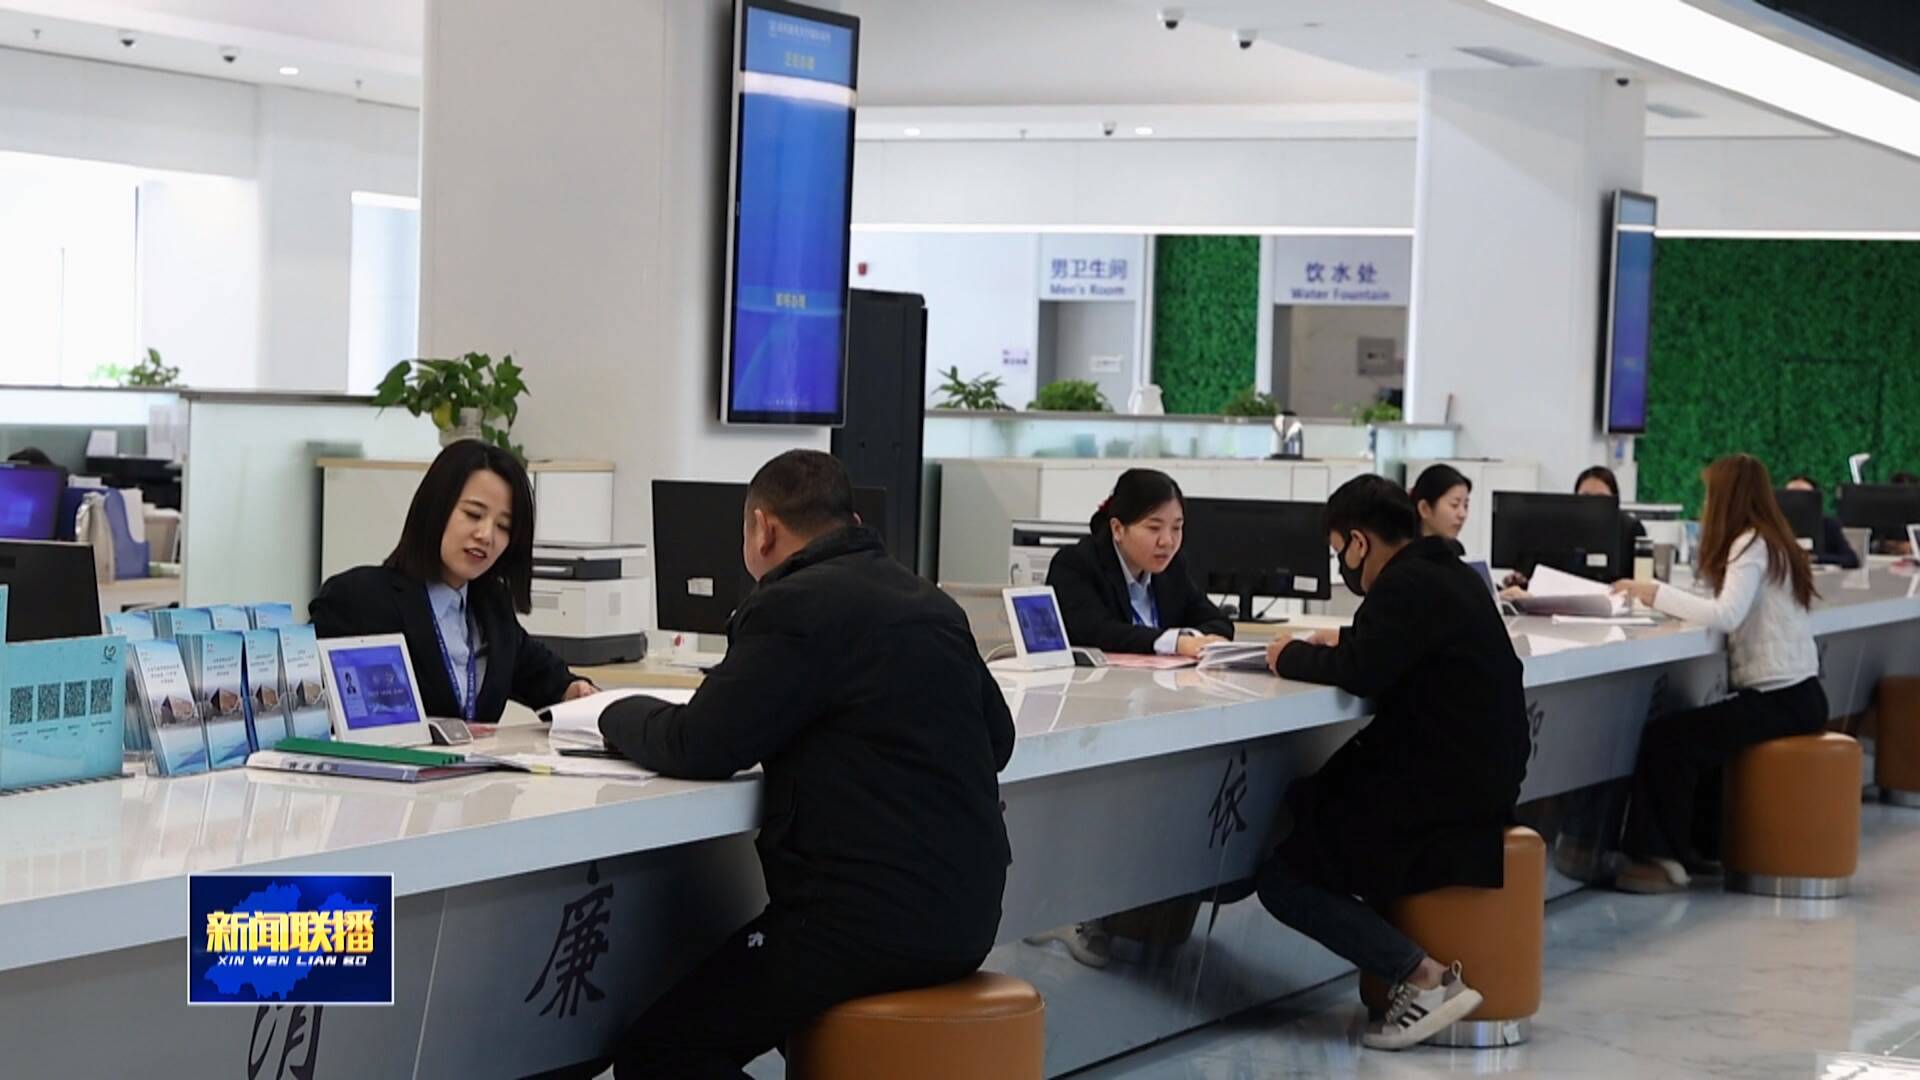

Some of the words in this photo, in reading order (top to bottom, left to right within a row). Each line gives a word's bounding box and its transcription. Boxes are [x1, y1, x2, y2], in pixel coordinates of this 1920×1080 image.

[1051, 258, 1128, 279] 男卫生间
[1304, 262, 1377, 283] 饮水处
[1049, 284, 1085, 295] Men's
[1089, 284, 1125, 296] Room
[1290, 288, 1329, 299] Water
[1332, 288, 1391, 300] Fountain
